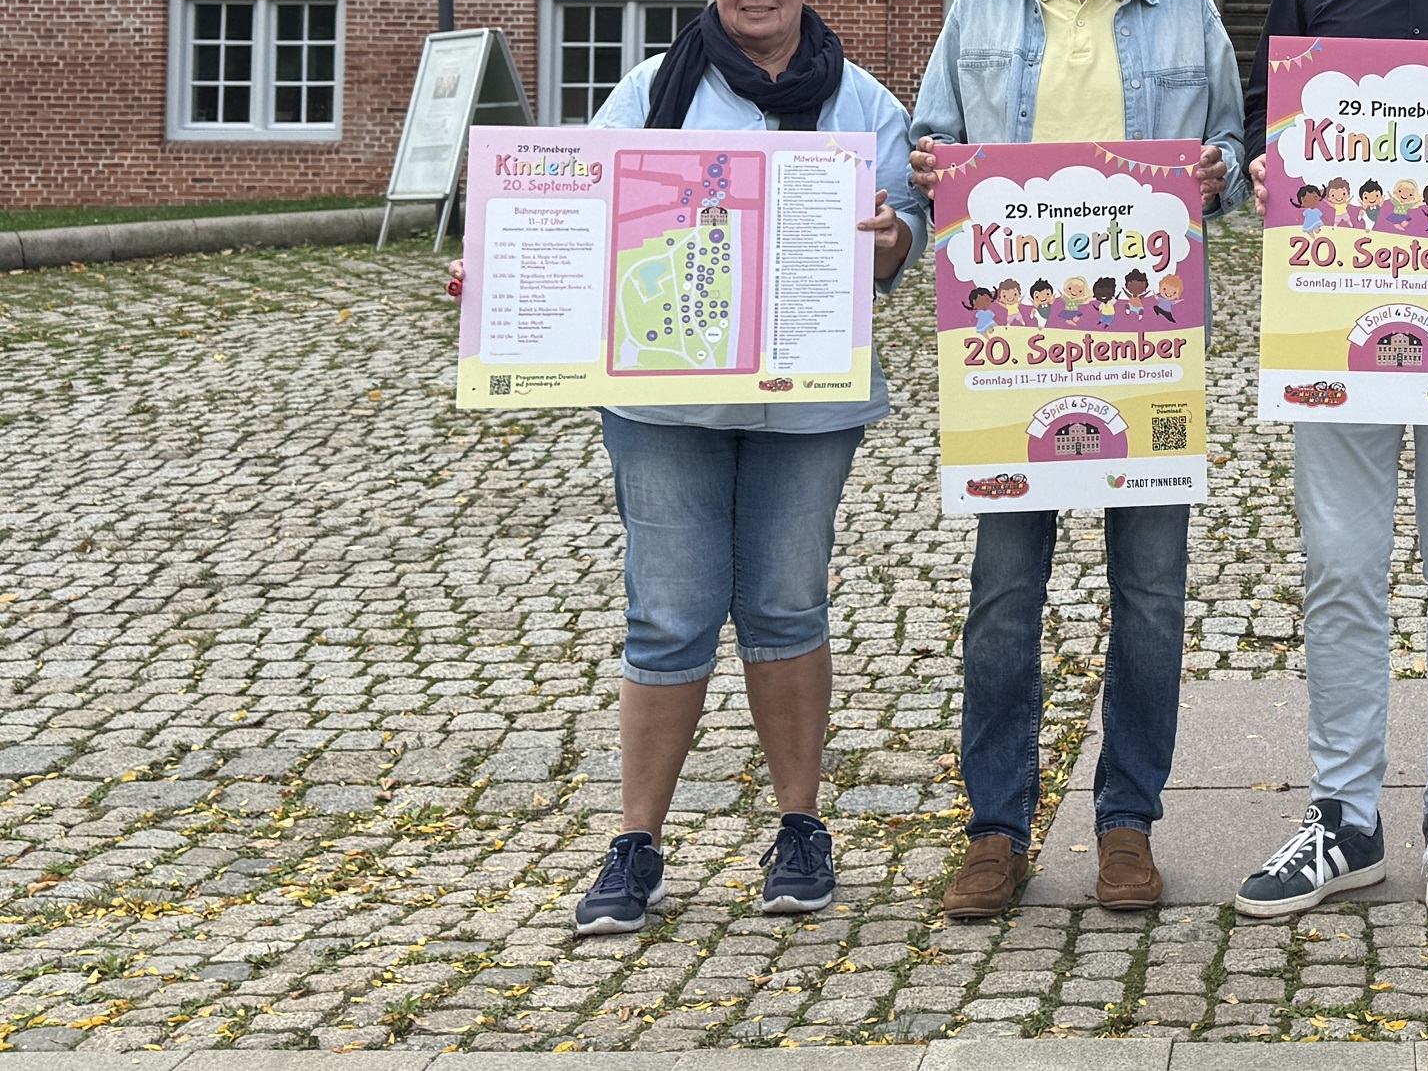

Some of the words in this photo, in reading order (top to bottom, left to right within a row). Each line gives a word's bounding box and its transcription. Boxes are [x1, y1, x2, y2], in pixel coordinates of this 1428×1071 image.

[1338, 100, 1366, 116] 29.
[533, 145, 580, 155] Pinneberger
[495, 154, 603, 184] Kindertag
[503, 180, 525, 191] 20.
[528, 180, 592, 194] September
[514, 207, 579, 216] Bühnenprogramm
[1005, 204, 1032, 219] 29.
[1037, 201, 1134, 221] Pinneberger
[971, 219, 1171, 273] Kindertag
[1288, 236, 1344, 267] 20.
[1295, 277, 1337, 291] Sonntag
[1375, 279, 1393, 289] Uhr
[1401, 279, 1427, 290] Rund
[1364, 307, 1392, 327] Spiel
[964, 336, 1019, 366] 20.
[1027, 331, 1187, 372] September
[972, 376, 1013, 387] Sonntag
[1050, 373, 1068, 382] Uhr
[1076, 371, 1101, 382] Rund
[1121, 371, 1136, 380] die
[1138, 369, 1173, 379] Drostei
[1042, 399, 1068, 419] Spiel
[1080, 398, 1110, 415] Spaß
[1126, 479, 1148, 488] STADT
[1150, 476, 1192, 487] PINNEBERG
